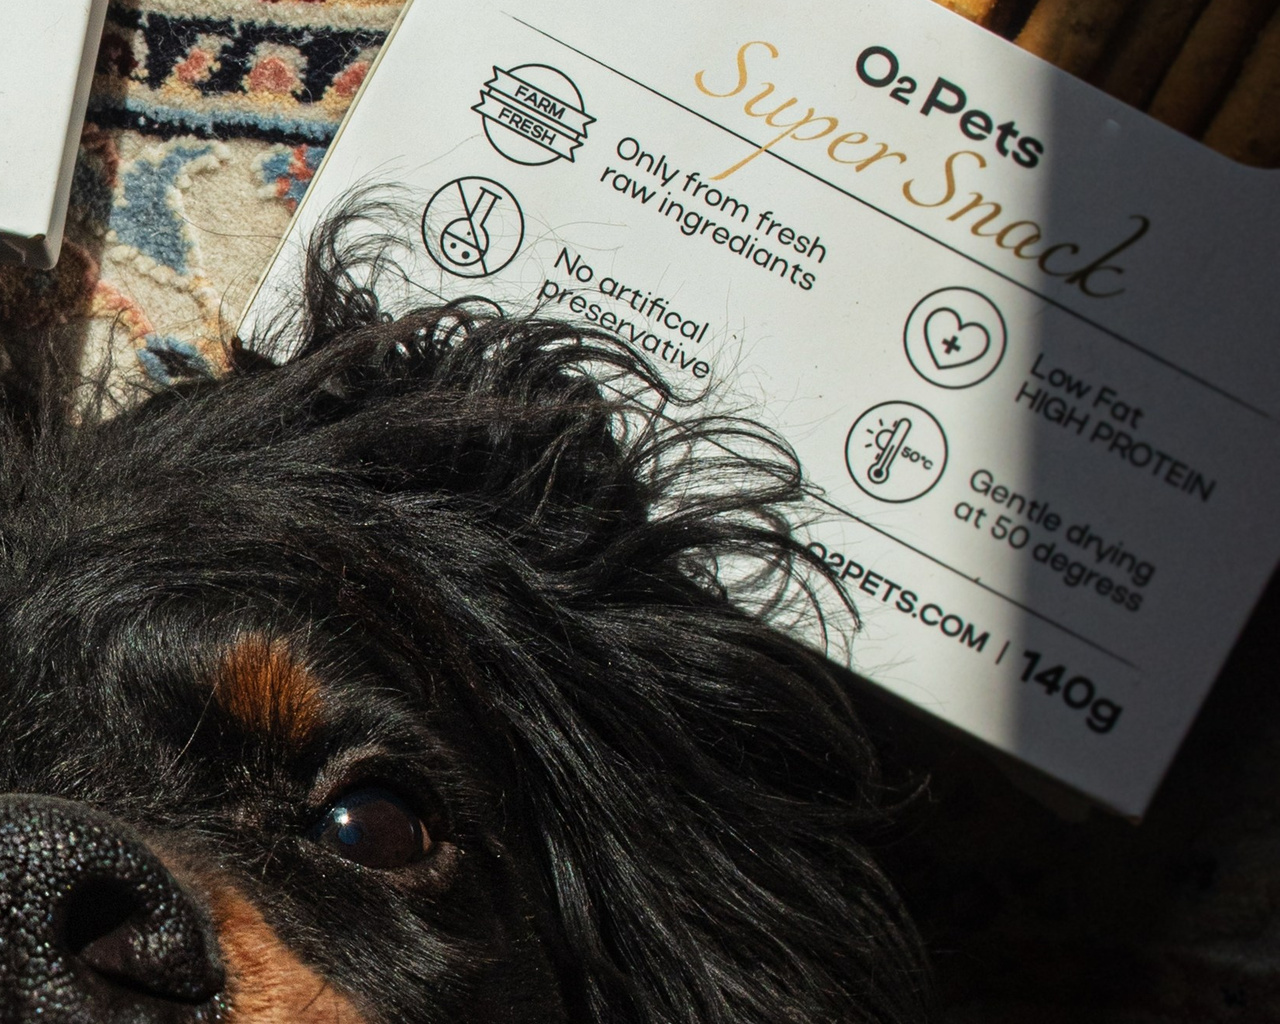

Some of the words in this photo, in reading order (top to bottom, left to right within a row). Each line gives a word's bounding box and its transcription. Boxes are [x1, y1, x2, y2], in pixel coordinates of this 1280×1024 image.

[498, 107, 557, 146] FRESH
[514, 85, 565, 120] FARM
[920, 77, 1044, 169] Pets
[616, 136, 680, 188] Only
[682, 172, 750, 223] from
[756, 211, 827, 263] fresh
[694, 41, 907, 181] Super
[902, 150, 1150, 299] Snack
[601, 165, 657, 204] raw
[658, 192, 816, 292] ingrediants
[537, 278, 710, 379] preservative
[553, 246, 597, 284] No
[599, 273, 709, 344] artifical
[1015, 381, 1089, 436] HIGH
[1090, 425, 1216, 502] PROTEIN
[1030, 353, 1091, 400] Low
[1092, 384, 1145, 430] Fat
[953, 501, 987, 530] at
[990, 515, 1030, 551] 50
[1033, 535, 1143, 613] degress
[969, 468, 1062, 532] Gentle
[1065, 520, 1156, 586] drying
[1021, 650, 1124, 734] 140g
